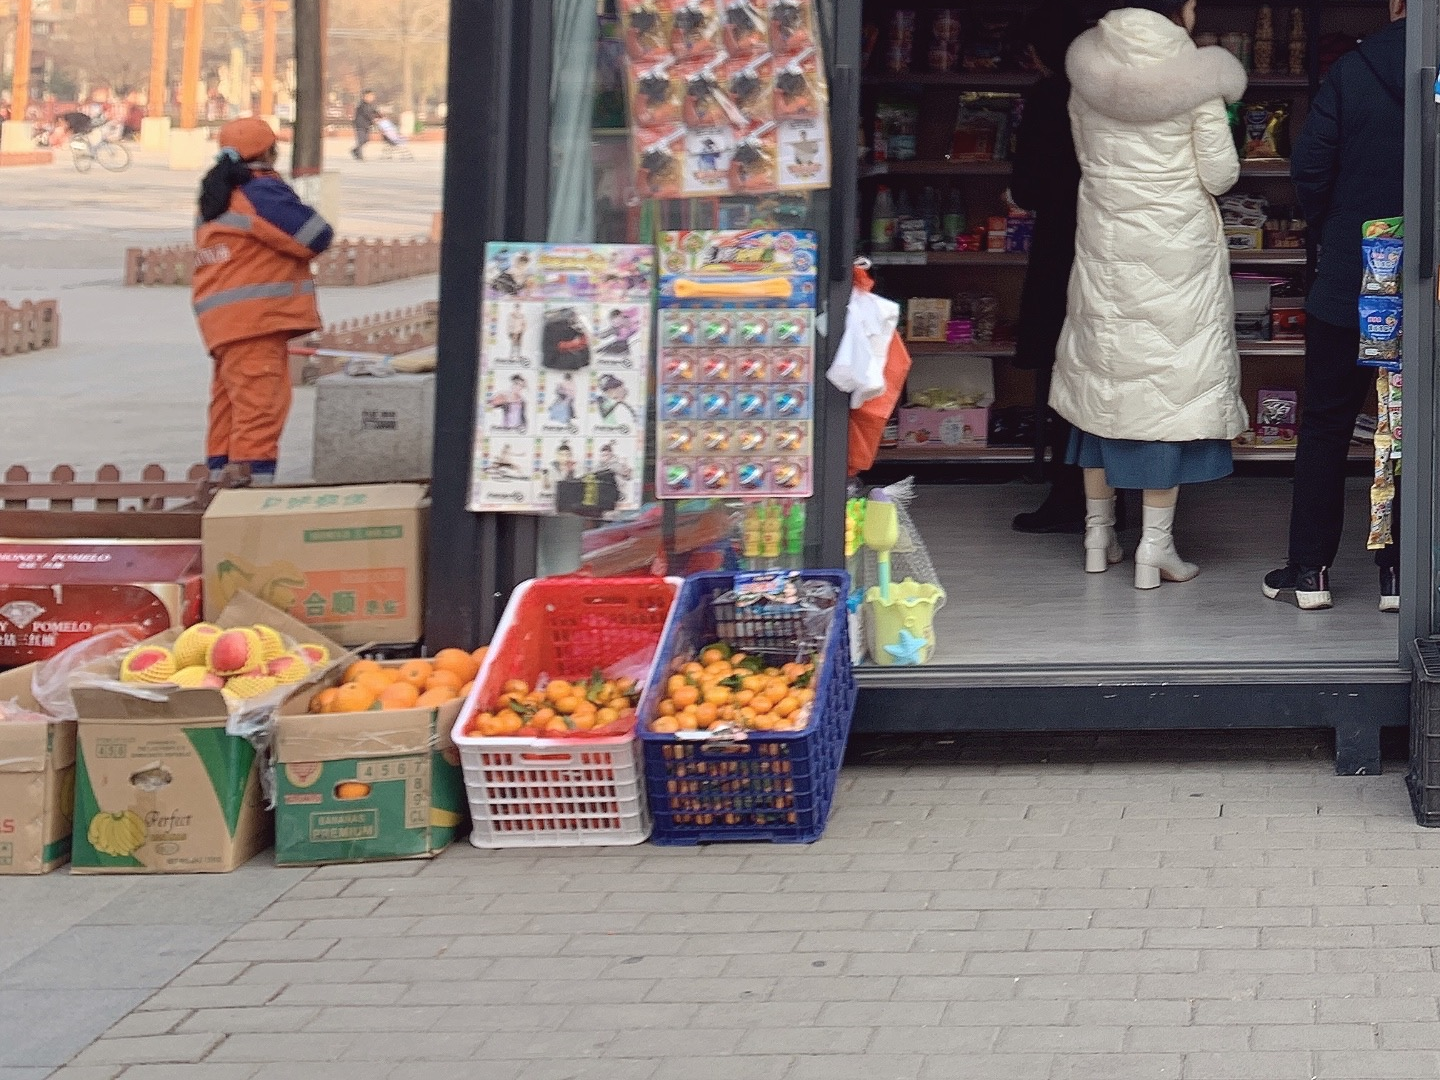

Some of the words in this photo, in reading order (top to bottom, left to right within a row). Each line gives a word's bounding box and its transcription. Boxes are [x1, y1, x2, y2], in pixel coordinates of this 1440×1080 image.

[52, 553, 112, 563] POMELO
[32, 621, 94, 633] POMELO
[381, 764, 390, 776] 5
[312, 825, 374, 841] PREMIUM
